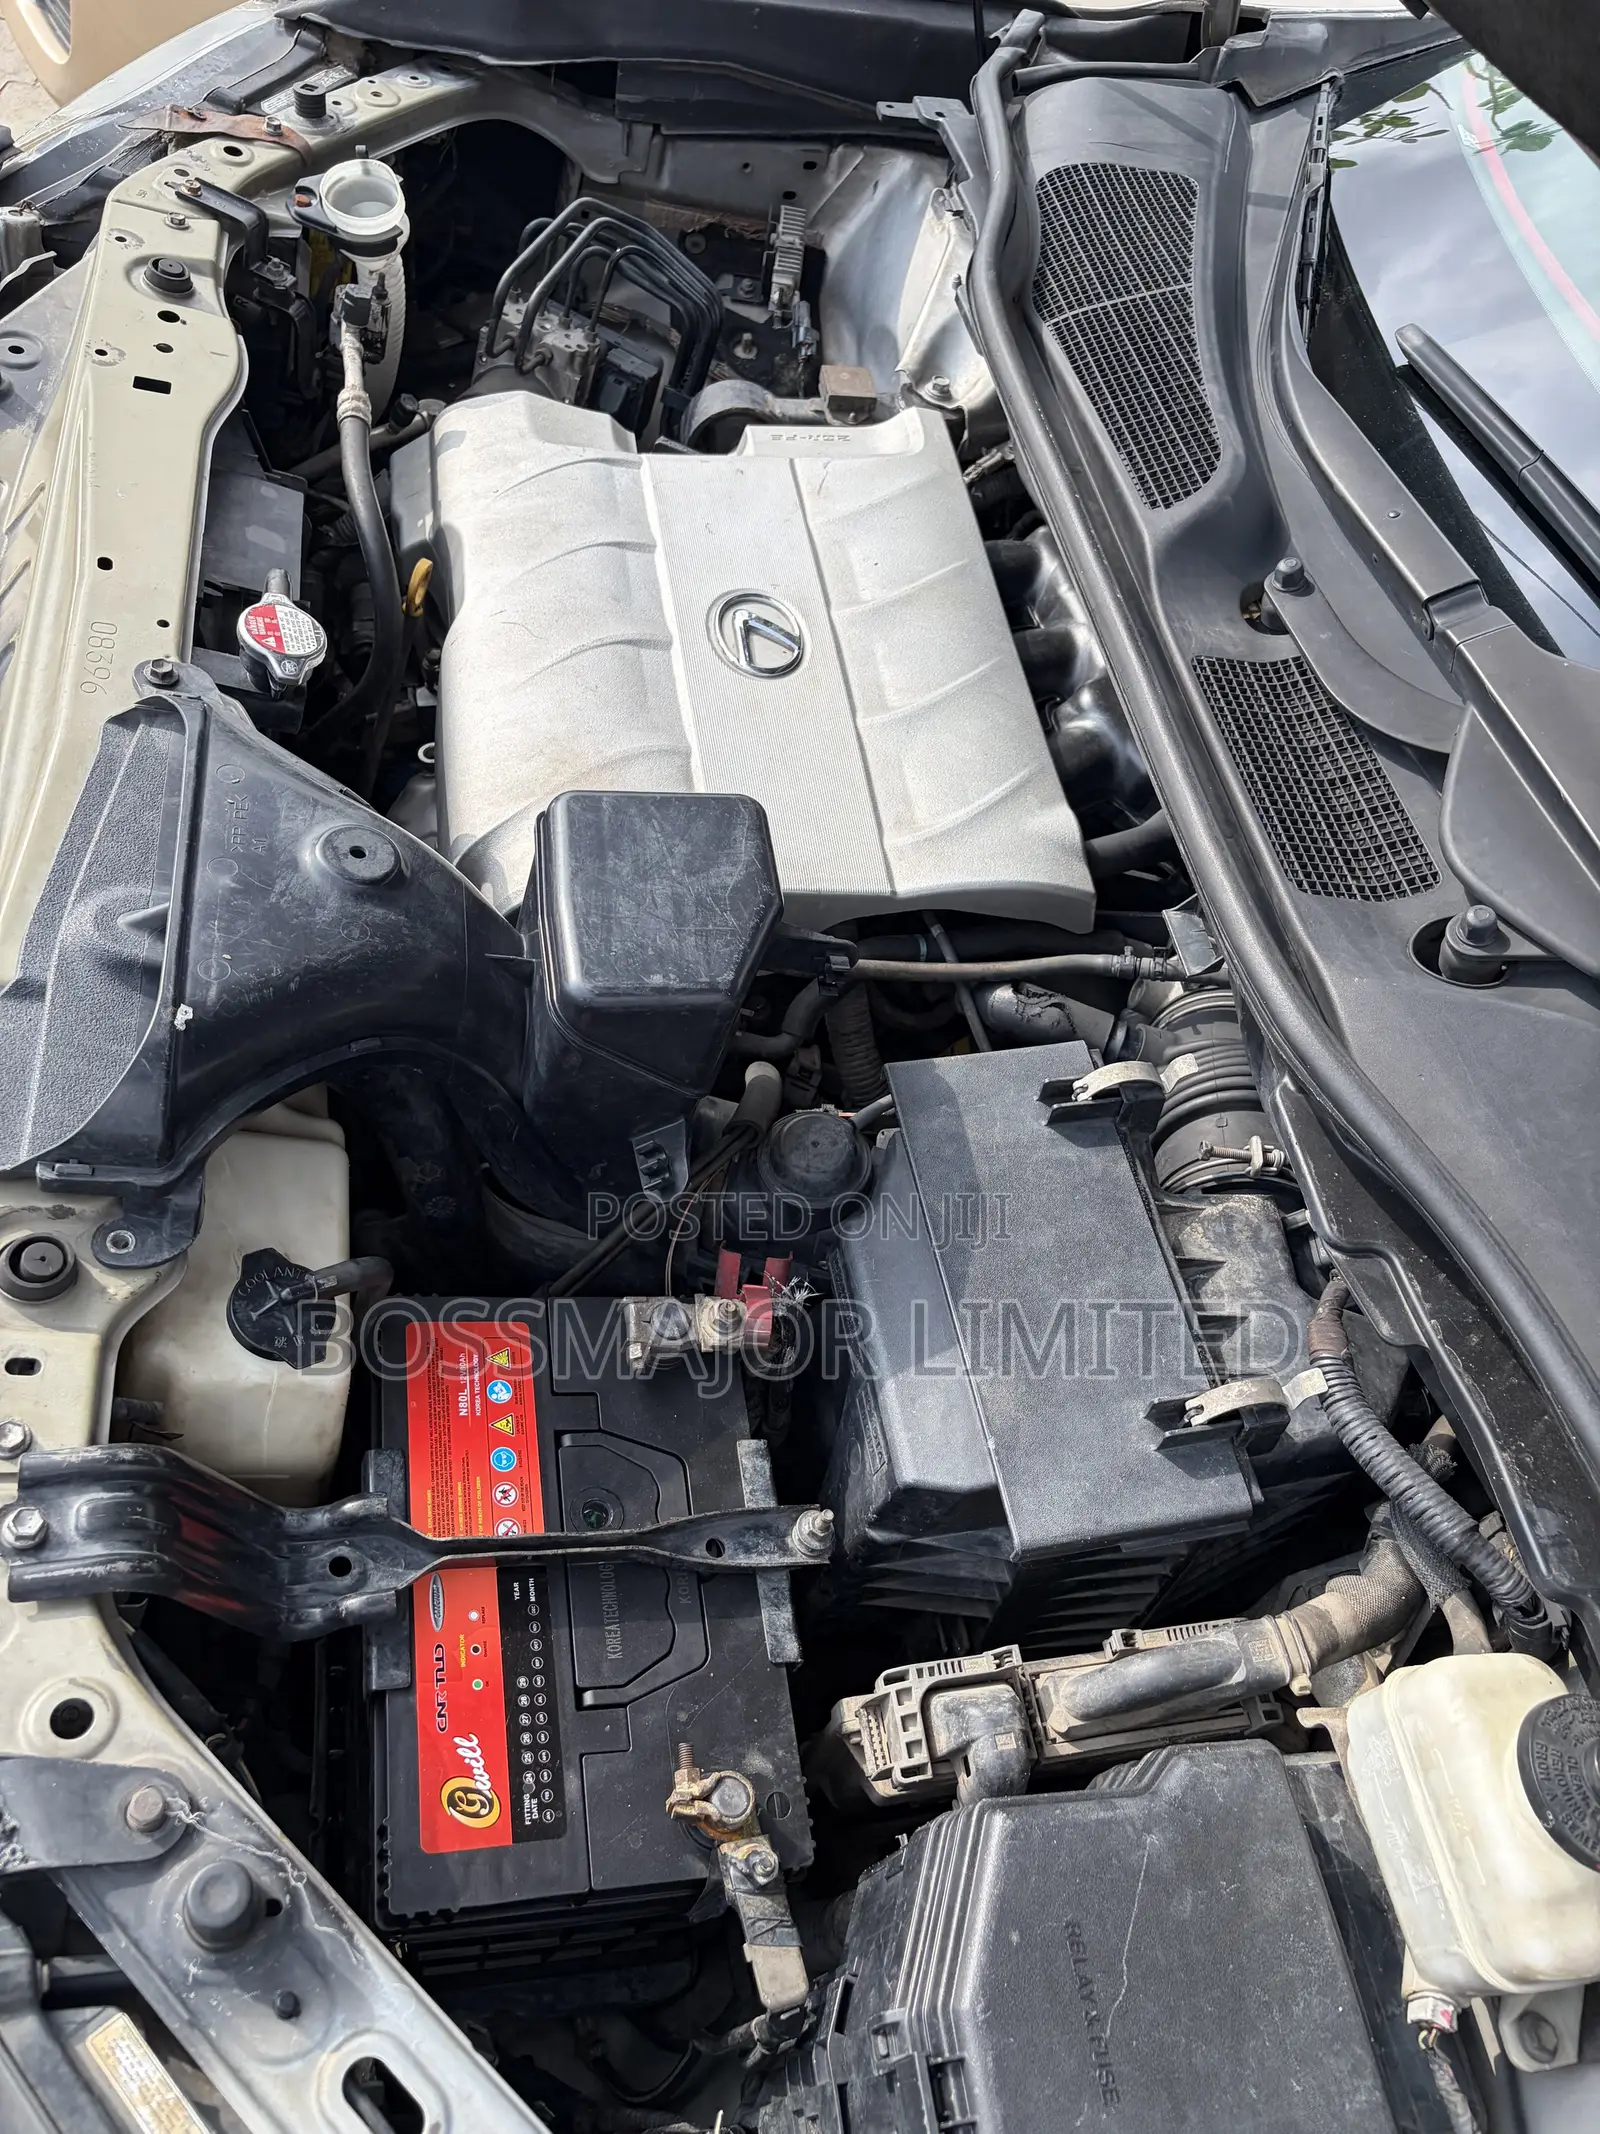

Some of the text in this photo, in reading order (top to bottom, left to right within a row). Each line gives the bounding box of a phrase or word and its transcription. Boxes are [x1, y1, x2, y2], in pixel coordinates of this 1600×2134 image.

[80, 621, 117, 695] 08396
[472, 1353, 481, 1396] TECHNOLOGY
[458, 1388, 469, 1417] N80L
[528, 1577, 536, 1602] MONTH
[458, 1633, 466, 1668] INDICATOR
[523, 1793, 531, 1825] FITTING
[531, 1797, 539, 1819] DATE
[1063, 1920, 1097, 2004] RELAY
[1088, 2034, 1121, 2108] FUSE
